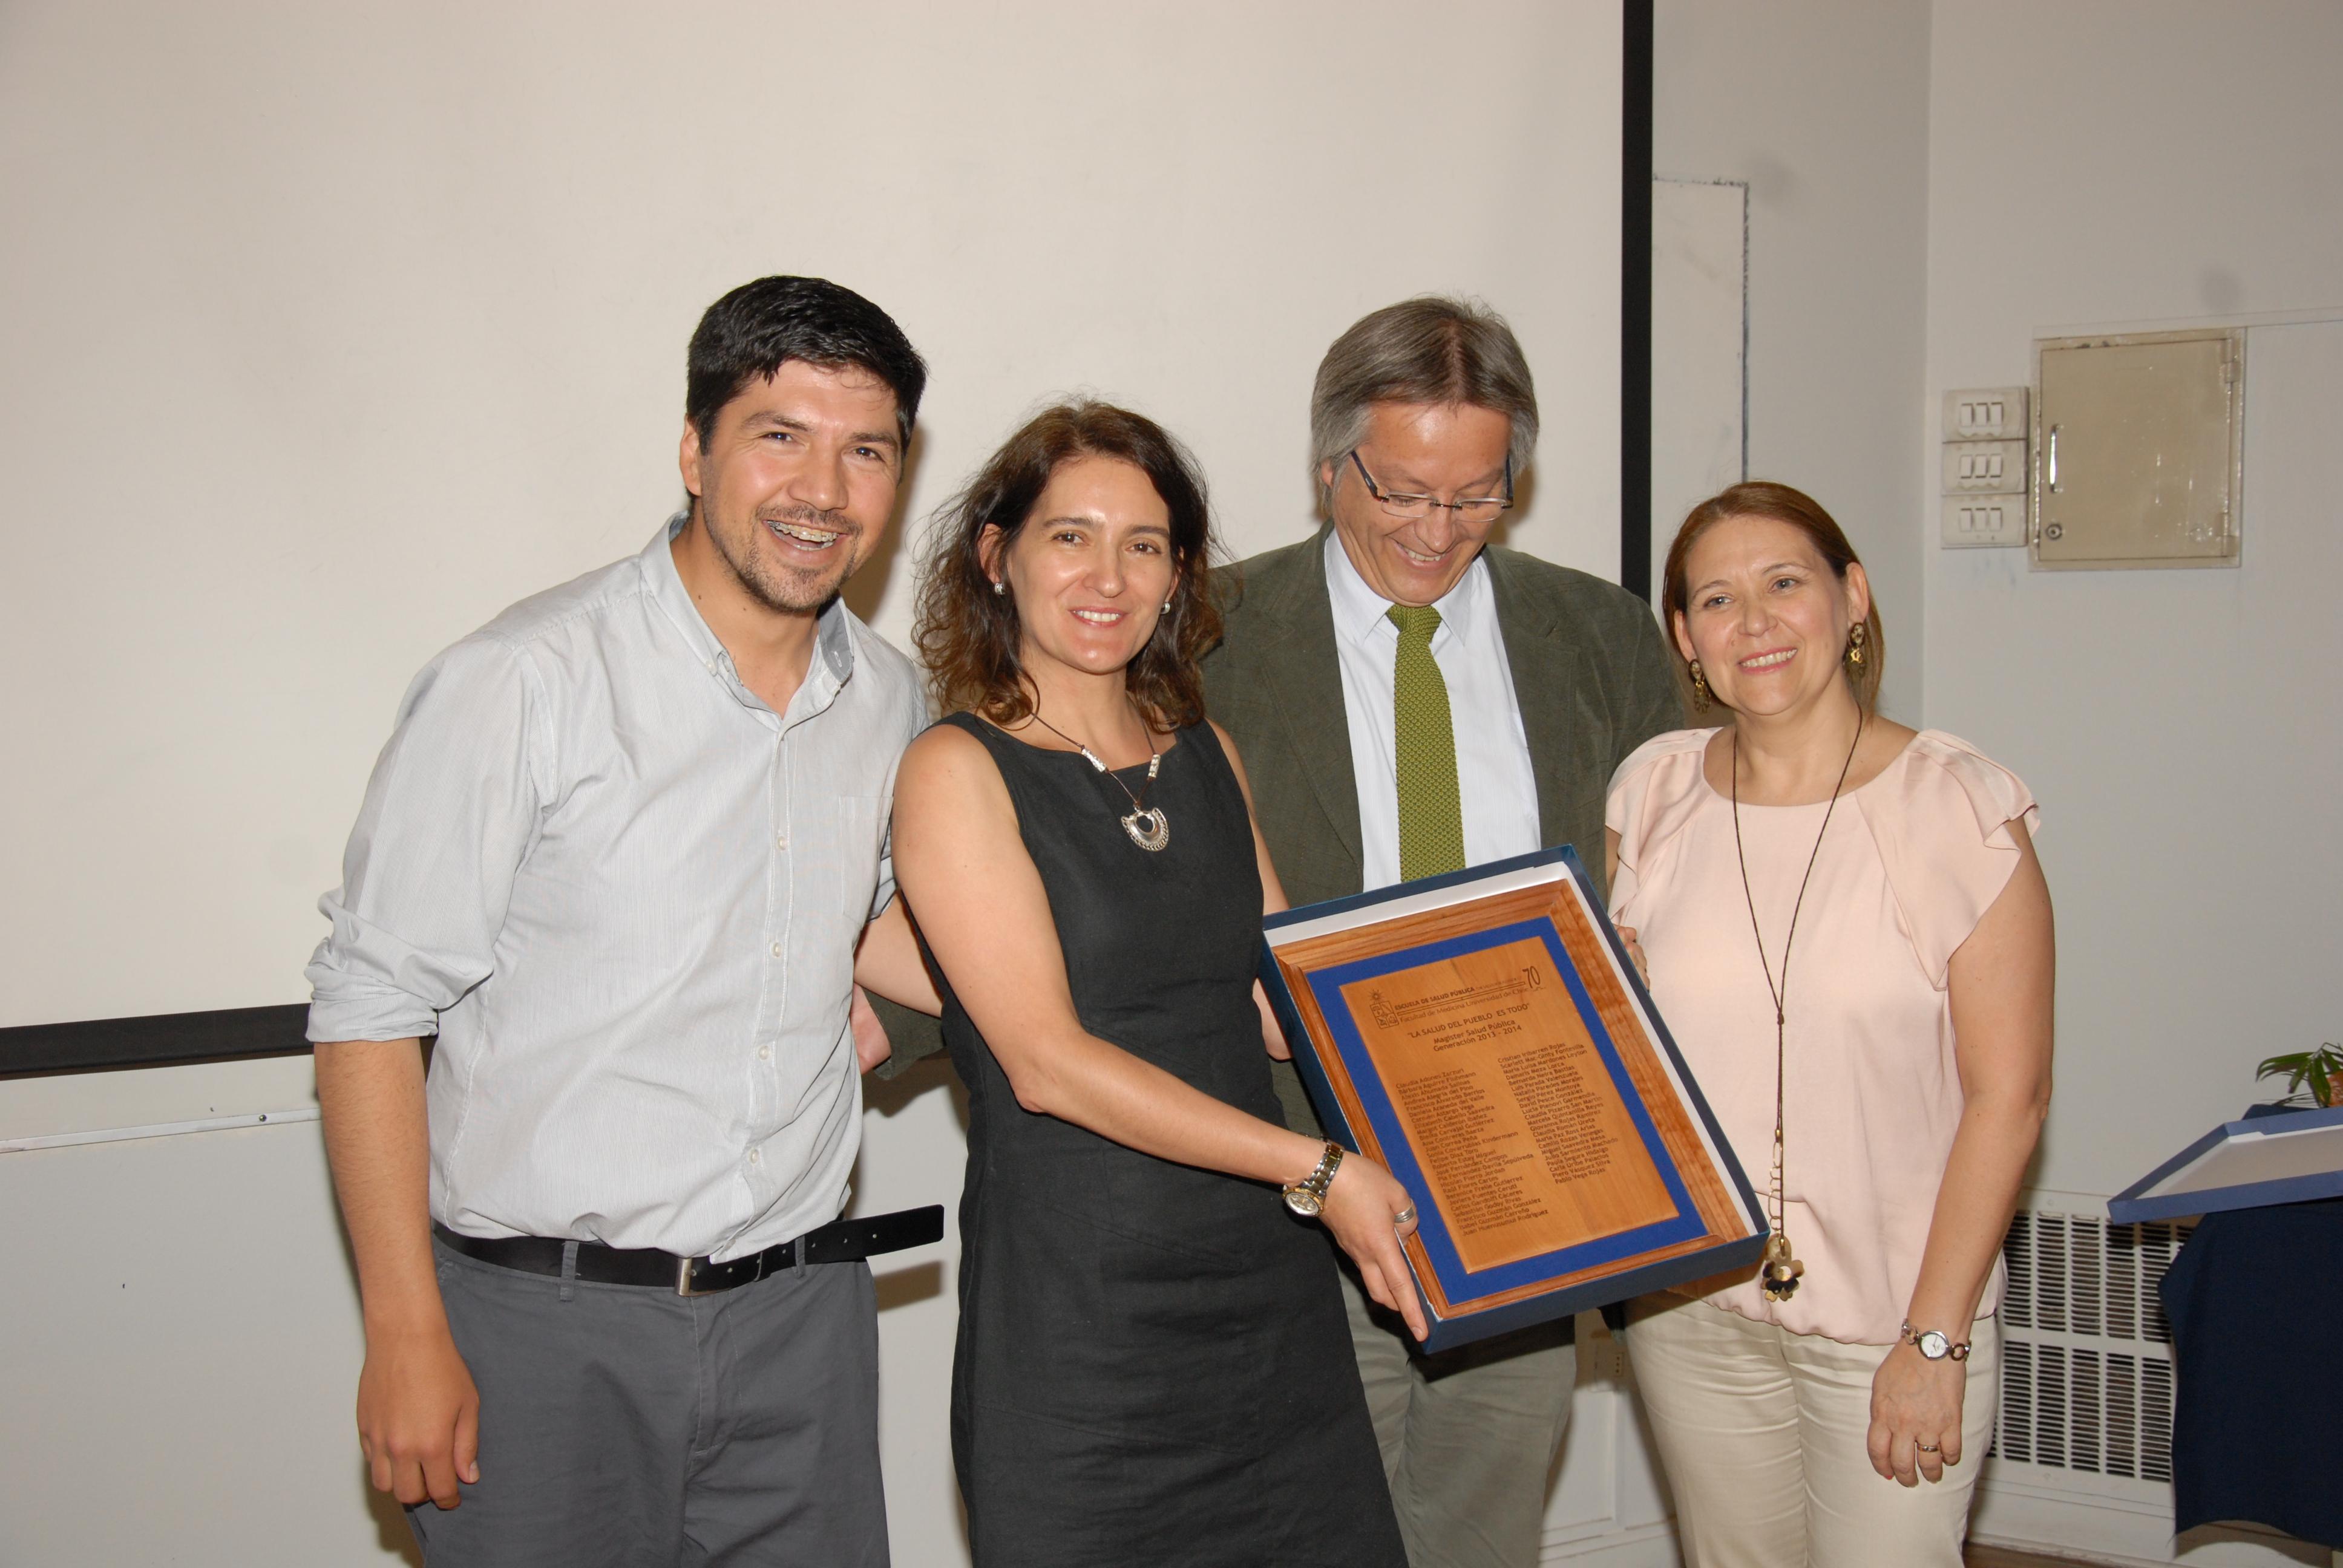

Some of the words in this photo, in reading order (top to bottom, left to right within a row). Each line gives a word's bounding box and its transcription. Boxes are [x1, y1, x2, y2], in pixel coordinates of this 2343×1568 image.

[1522, 965, 1541, 988] 70
[1394, 1001, 1420, 1011] ESCUELA
[1430, 993, 1449, 1002] SALUD
[1450, 987, 1475, 996] PÚBLICA
[1400, 1012, 1426, 1024] Facultad
[1437, 1004, 1464, 1014] Medicina
[1466, 993, 1502, 1007] Universidad
[1421, 1025, 1446, 1036] SALUD
[1447, 1021, 1462, 1029] DEL
[1464, 1013, 1492, 1025] PUEBLO
[1434, 1033, 1464, 1044] Magister
[1466, 1026, 1486, 1036] Salud
[1488, 1020, 1515, 1030] Pública
[1434, 1038, 1475, 1052] Generación
[1478, 1031, 1496, 1040] 2013
[1503, 1025, 1522, 1034] 2014
[1500, 1059, 1524, 1069] Scarlett
[1546, 1071, 1578, 1082] Valenzuela
[1406, 1102, 1435, 1112] Francisco
[1436, 1094, 1463, 1105] Alvarado
[1432, 1102, 1458, 1112] Araneda
[1467, 1106, 1495, 1116] Saavedra
[1525, 1111, 1547, 1120] Claudia
[1548, 1105, 1570, 1114] Pizarro
[1527, 1117, 1550, 1126] Marcela
[1552, 1108, 1585, 1119] Quintanilla
[1530, 1122, 1558, 1132] Giovanna
[1533, 1128, 1555, 1137] Claudia
[1435, 1133, 1464, 1143] Contreras
[1483, 1132, 1518, 1144] Kindermann
[1538, 1140, 1559, 1149] Camilo
[1541, 1146, 1561, 1155] Miguel
[1562, 1139, 1589, 1149] Saavedra
[1560, 1145, 1591, 1156] Sarmiento
[1592, 1138, 1618, 1148] Machado
[1586, 1147, 1608, 1156] Hidalgo
[1502, 1154, 1533, 1165] Sepúlveda
[1584, 1154, 1609, 1163] Palacios
[1457, 1213, 1486, 1224] Francisco
